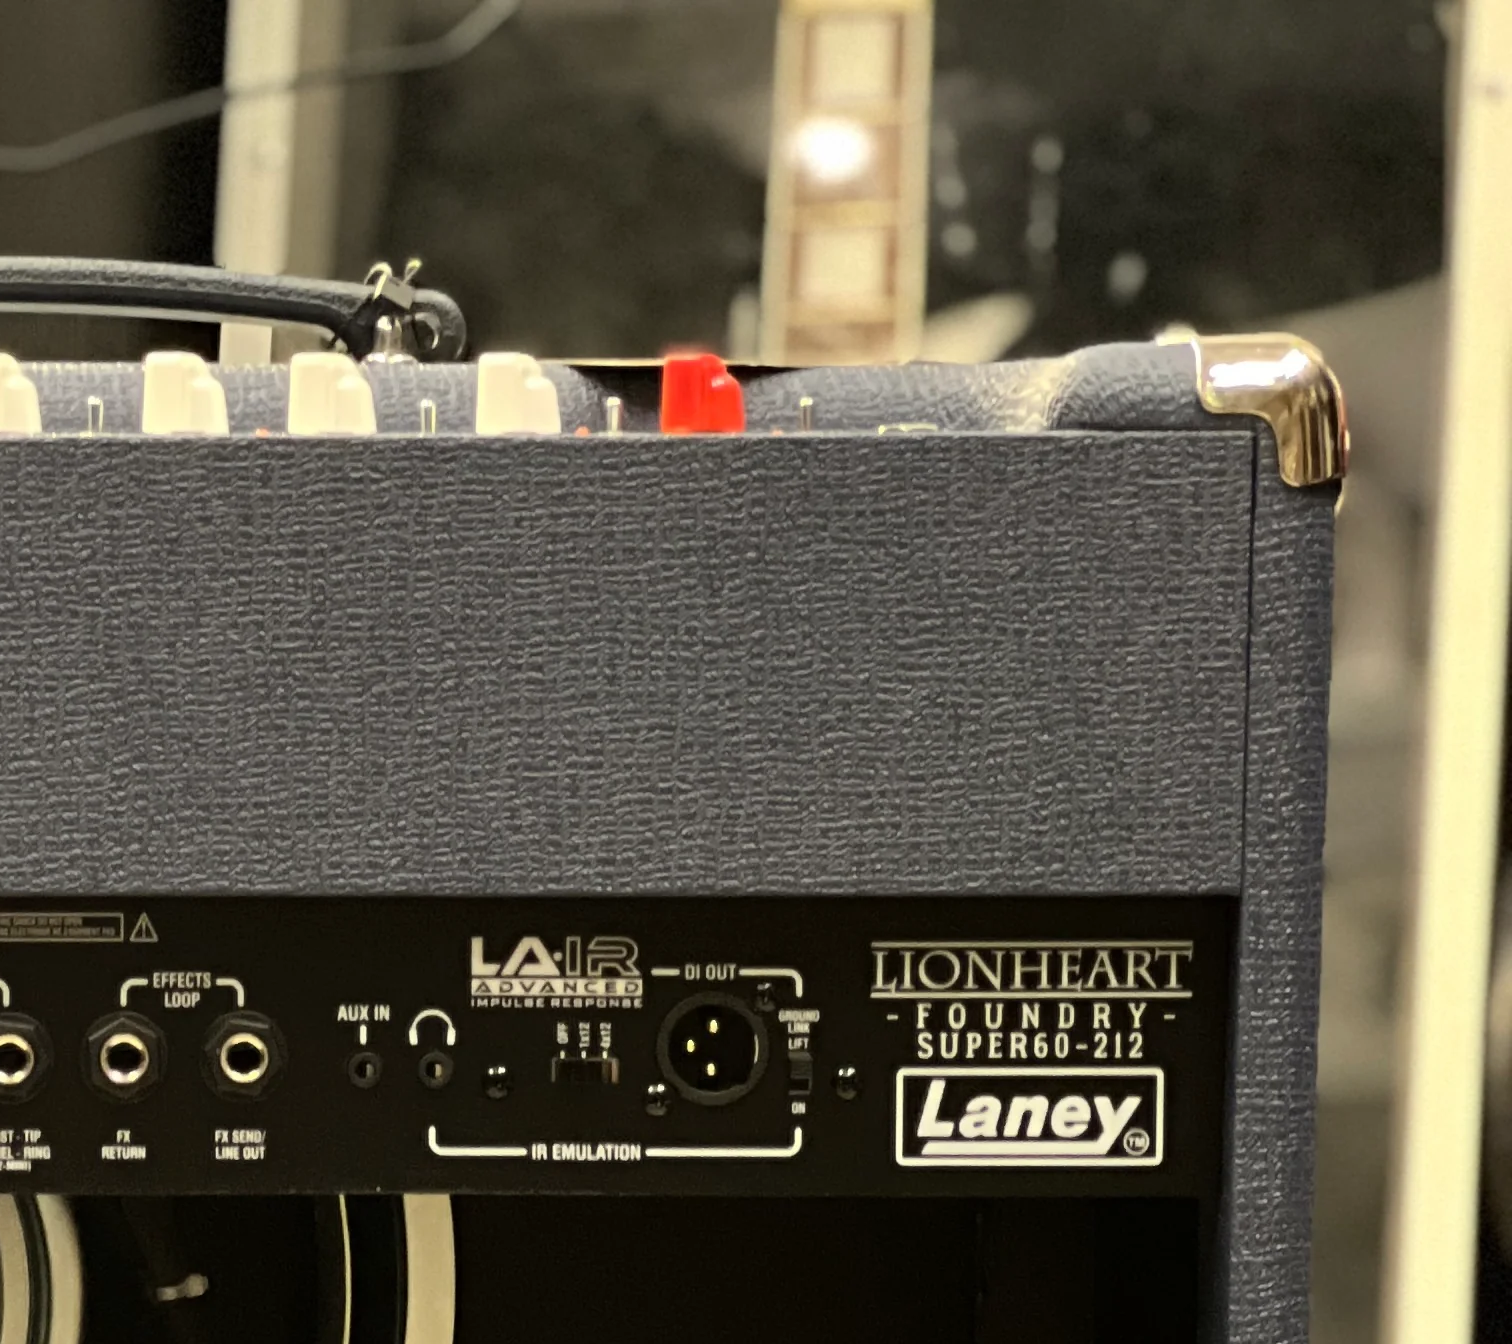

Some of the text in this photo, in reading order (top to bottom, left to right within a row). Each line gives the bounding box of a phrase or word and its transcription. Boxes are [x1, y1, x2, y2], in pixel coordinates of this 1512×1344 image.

[684, 964, 737, 981] DI OUT
[871, 948, 1194, 993] LIONHEART
[152, 972, 212, 989] EFFECTS
[474, 980, 640, 993] ADVANCED
[164, 991, 201, 1009] LOOP
[471, 997, 643, 1009] IMPULSE RESPONSE
[337, 1004, 390, 1022] AUX IN
[778, 1009, 820, 1022] GROUND
[916, 1002, 1148, 1030] FOUNDRY
[787, 1022, 810, 1034] LINK
[788, 1037, 810, 1050] LIFT
[916, 1032, 1144, 1060] SUPER60-212
[791, 1102, 806, 1115] ON
[917, 1079, 1143, 1155] Laney
[23, 1129, 42, 1144] TIP
[116, 1129, 131, 1143] FX
[214, 1129, 266, 1143] FX SEND/
[23, 1145, 51, 1160] RING
[101, 1145, 147, 1160] RETURN
[215, 1145, 266, 1160] LINE OUT
[531, 1143, 641, 1161] IR EMULATION
